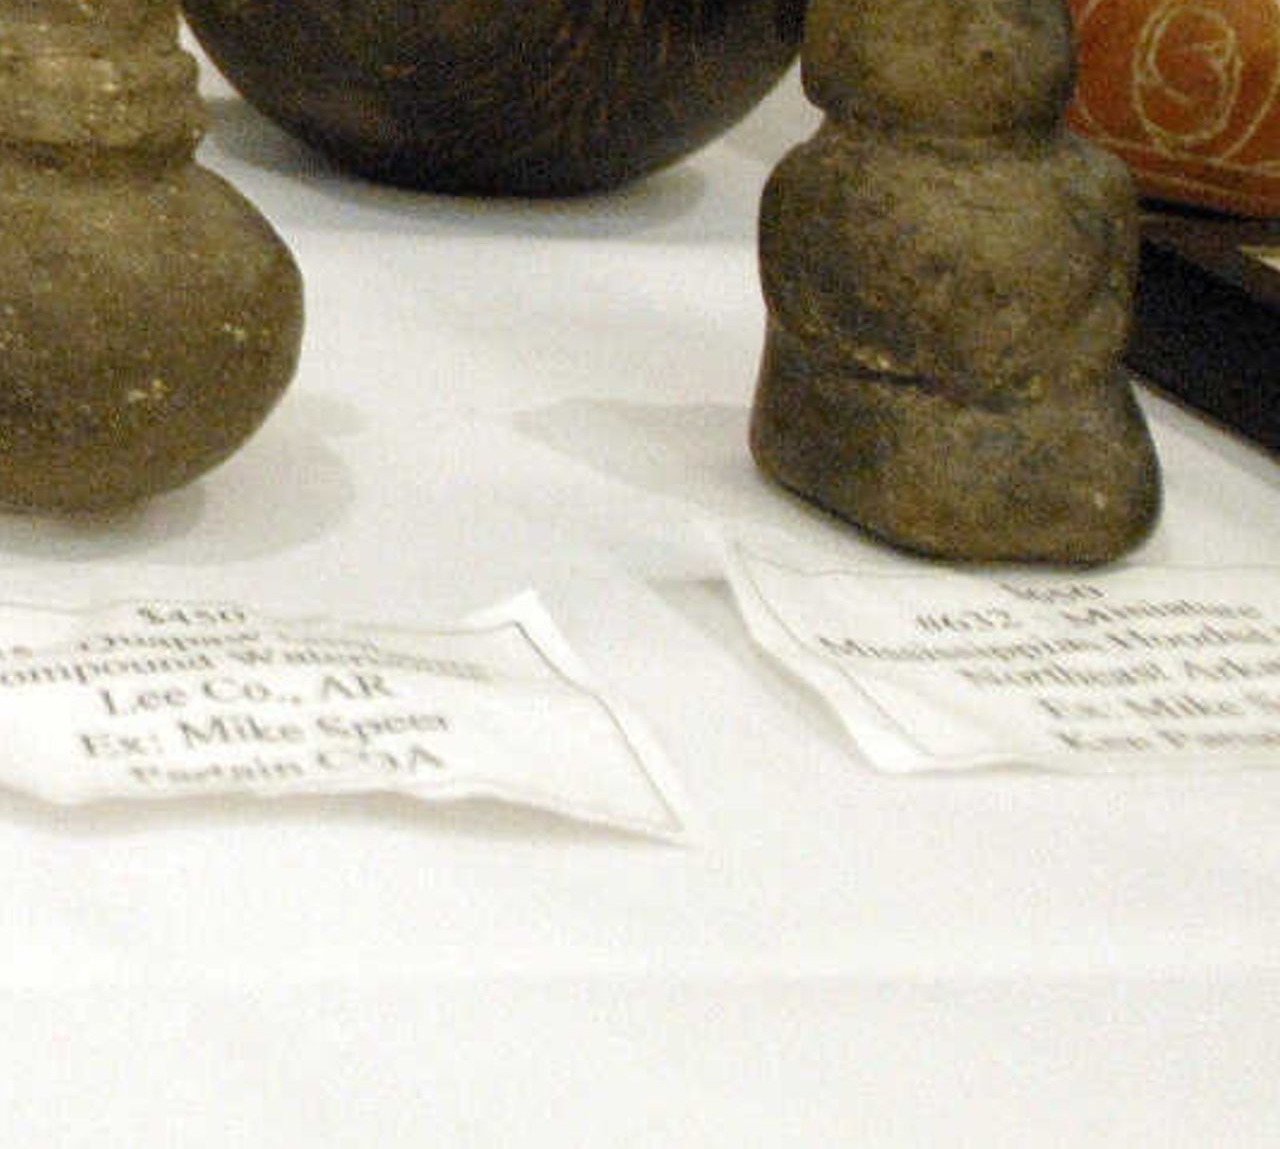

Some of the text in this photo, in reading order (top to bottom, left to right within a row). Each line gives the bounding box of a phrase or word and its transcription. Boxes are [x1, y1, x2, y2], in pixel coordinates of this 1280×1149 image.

[1060, 600, 1264, 626] Miniature
[954, 661, 1172, 688] Northeast
[97, 672, 396, 718] Lee Co., AR
[1122, 693, 1246, 720] Mike
[79, 729, 167, 759] Ex:
[177, 714, 305, 751] Mike
[128, 754, 305, 784] Partain
